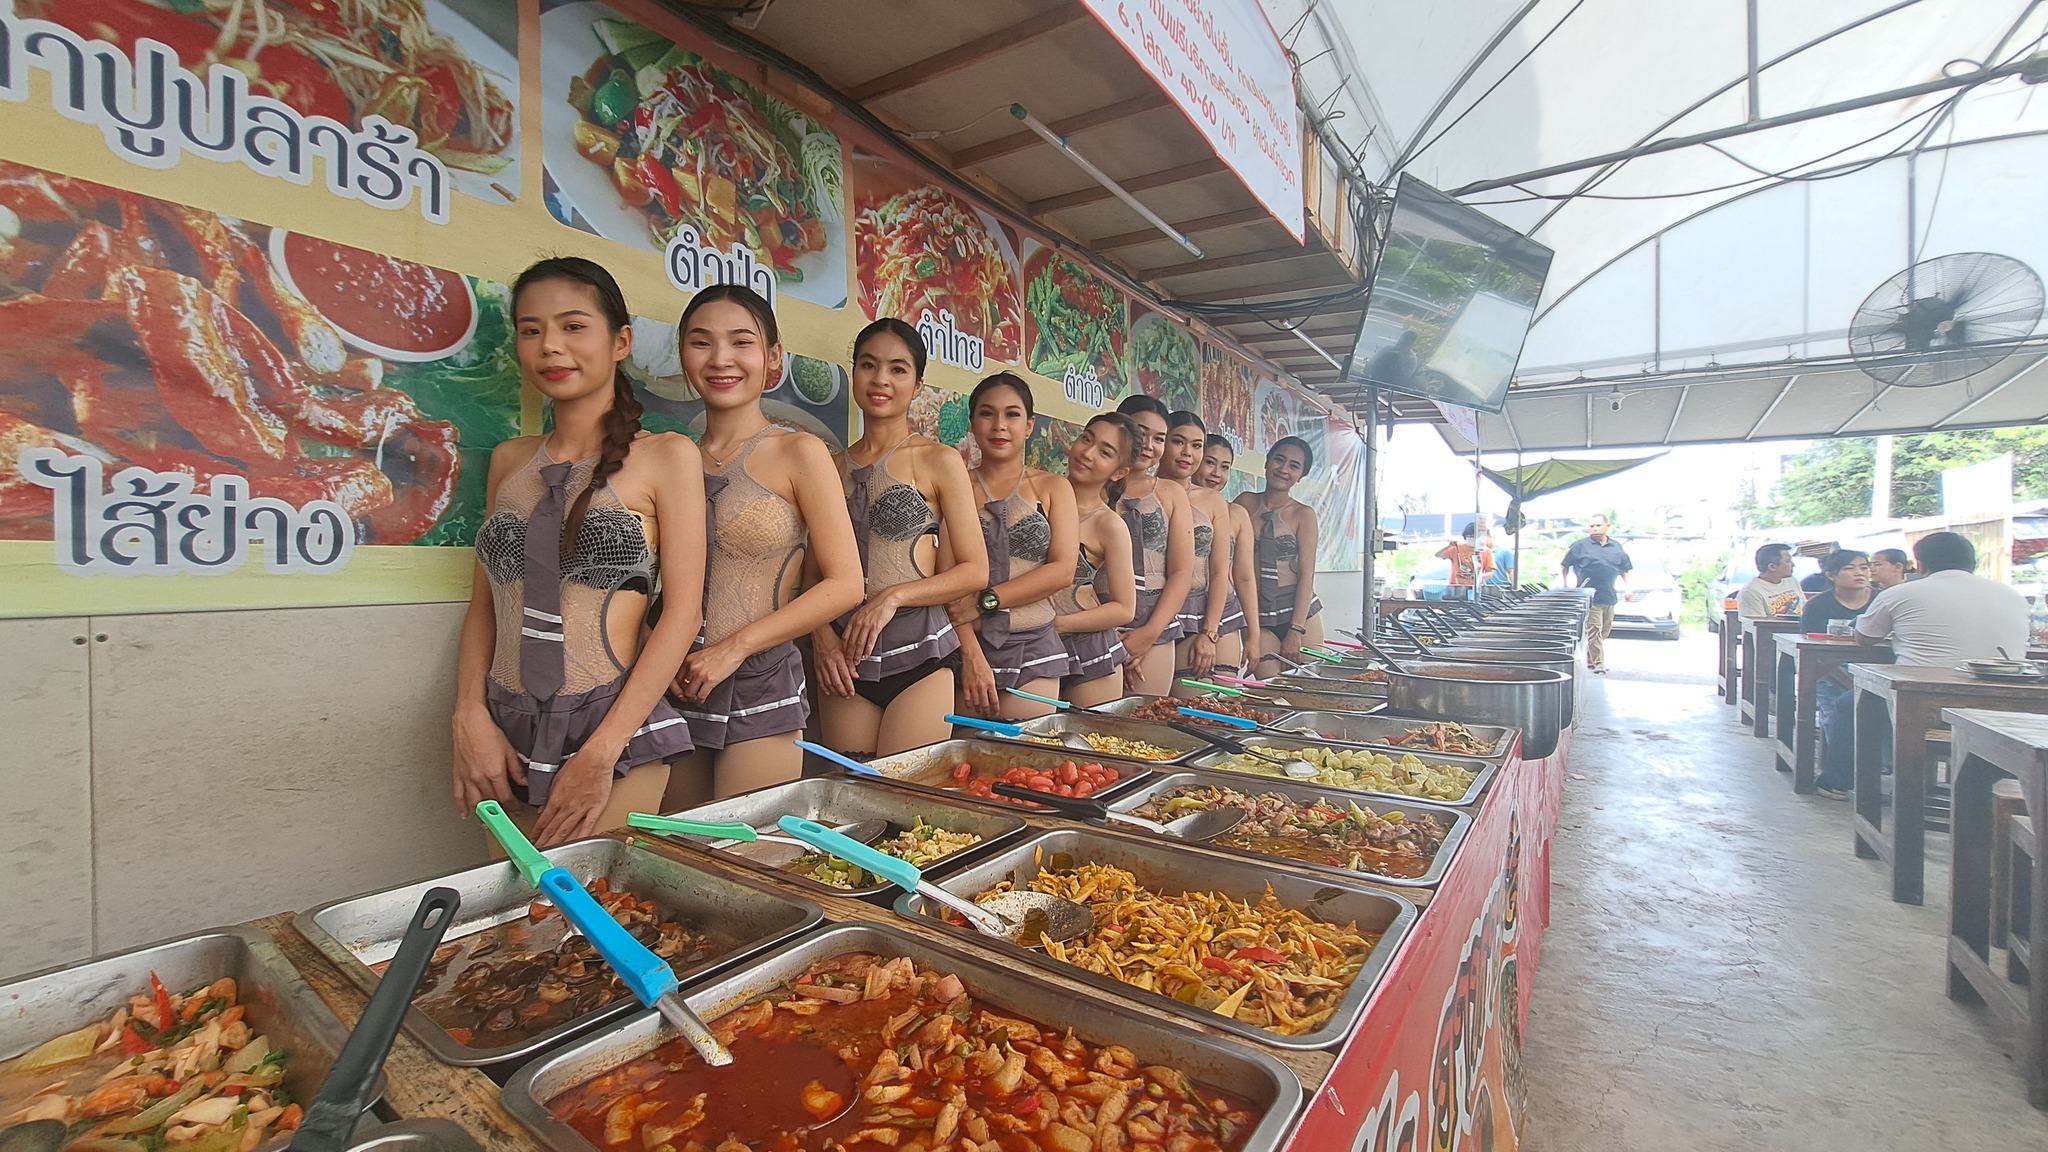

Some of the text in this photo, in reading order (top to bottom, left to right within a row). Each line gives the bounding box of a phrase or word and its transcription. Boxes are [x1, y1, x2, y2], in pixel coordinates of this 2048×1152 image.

[1181, 72, 1217, 126] 40-60
[1221, 117, 1237, 154] บาท
[920, 313, 983, 369] ตำไทย
[35, 458, 345, 566] ไส้ย่าง
